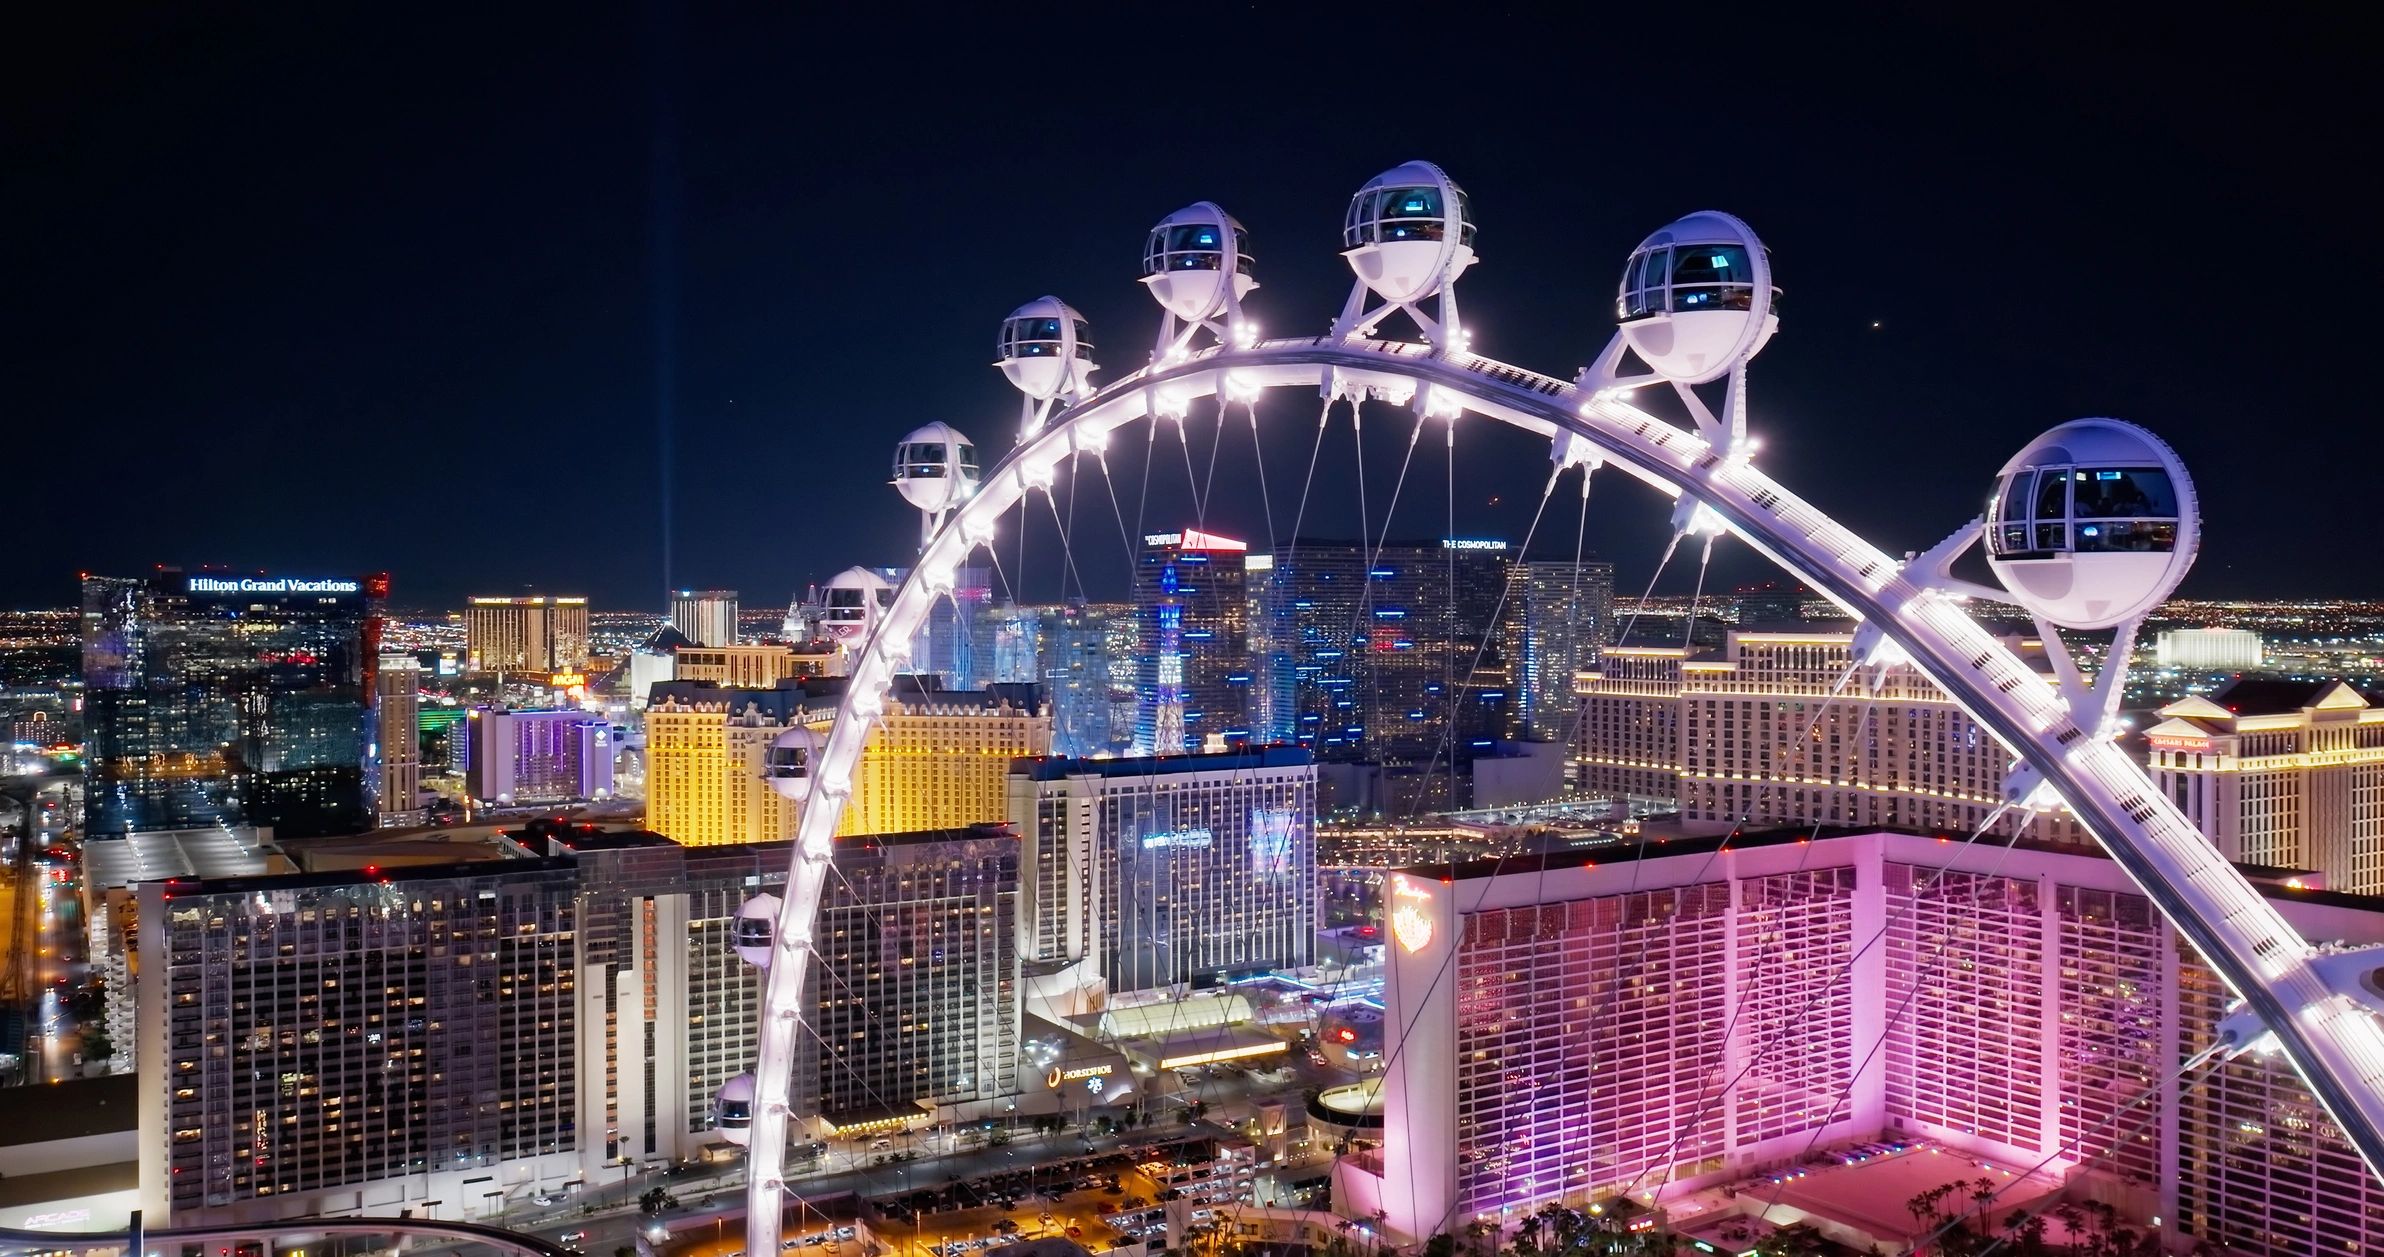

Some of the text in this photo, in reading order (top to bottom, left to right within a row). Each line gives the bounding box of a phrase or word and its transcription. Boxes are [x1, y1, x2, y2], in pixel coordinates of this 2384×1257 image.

[1442, 540, 1507, 550] THE COSMOPOLITAN
[190, 578, 357, 592] Hilton Grand Vacations
[552, 674, 585, 685] MGM
[1063, 1064, 1113, 1080] HORSESHOE
